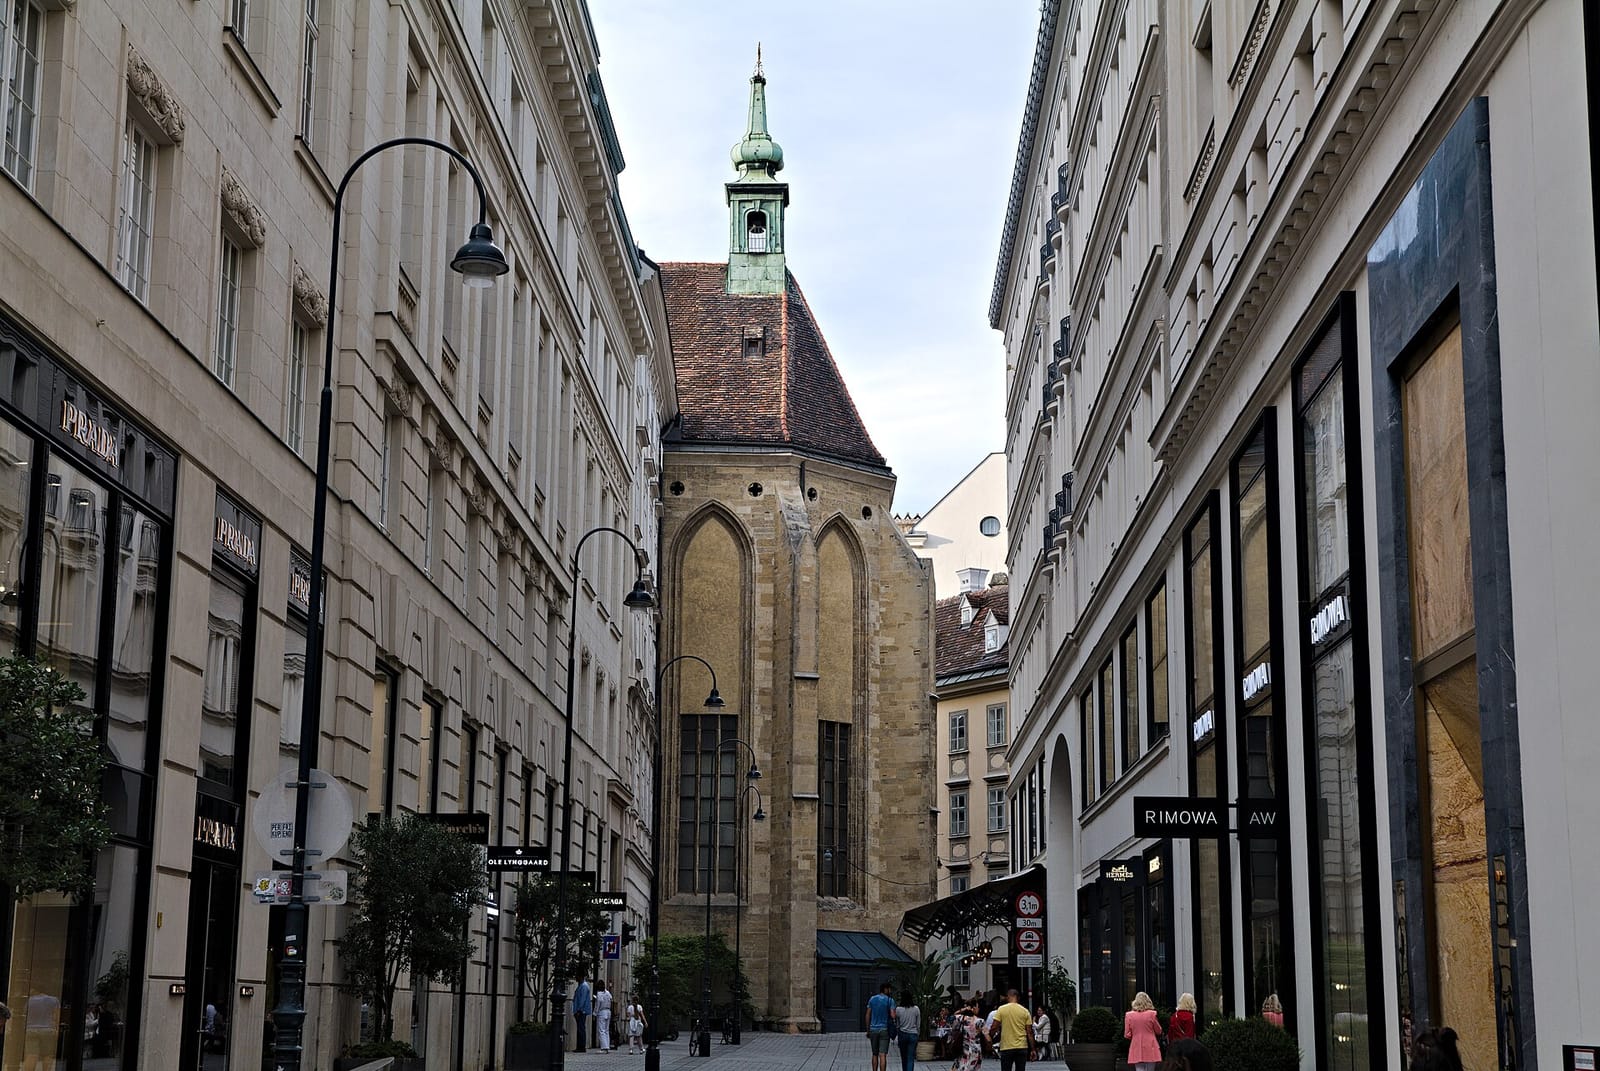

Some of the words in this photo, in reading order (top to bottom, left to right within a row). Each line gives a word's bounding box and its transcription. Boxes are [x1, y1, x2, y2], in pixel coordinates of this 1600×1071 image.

[61, 400, 119, 469] PRADA
[214, 517, 257, 566] PRADA
[1310, 596, 1345, 644] RIMOWA
[1145, 810, 1218, 825] RIMOWA
[488, 858, 502, 866] OLE
[1022, 919, 1037, 927] 30m
